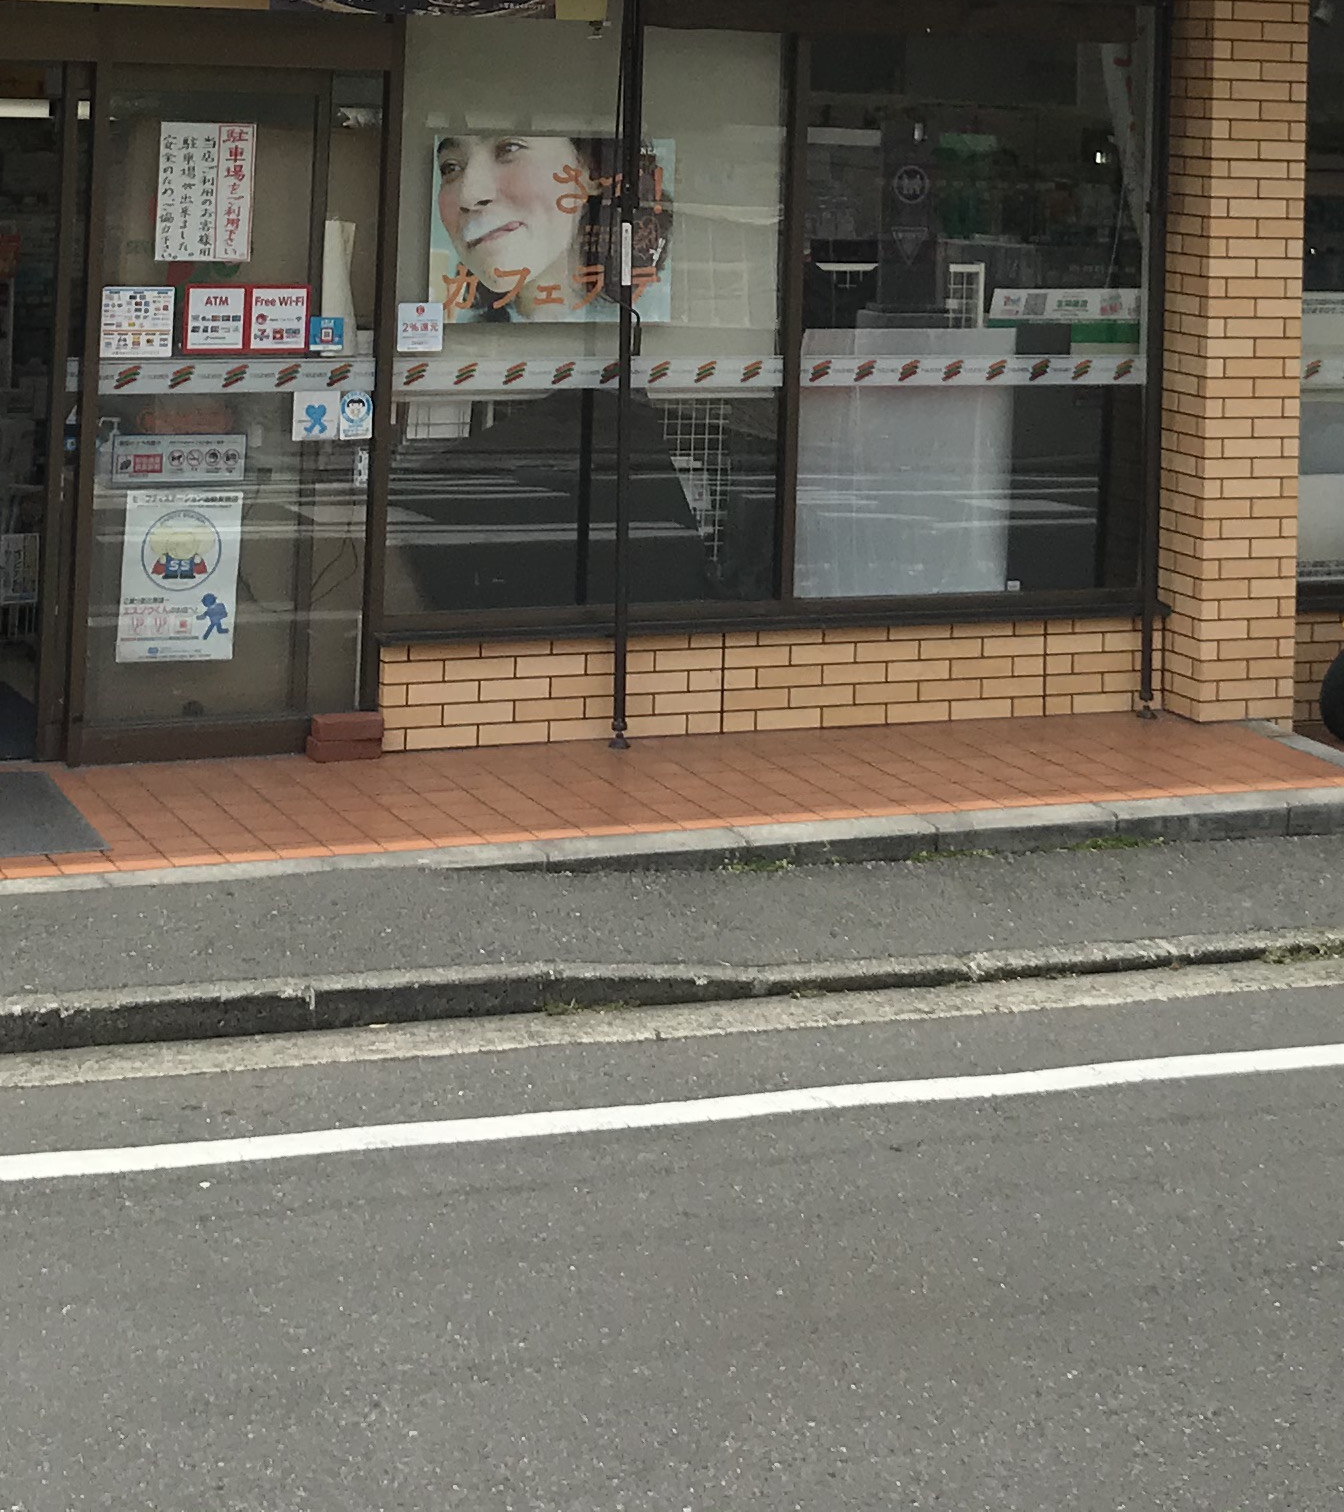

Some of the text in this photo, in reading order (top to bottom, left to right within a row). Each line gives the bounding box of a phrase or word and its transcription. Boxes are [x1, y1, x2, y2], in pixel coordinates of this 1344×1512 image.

[204, 295, 229, 307] ATM
[255, 295, 304, 307] Free Wi-Fi
